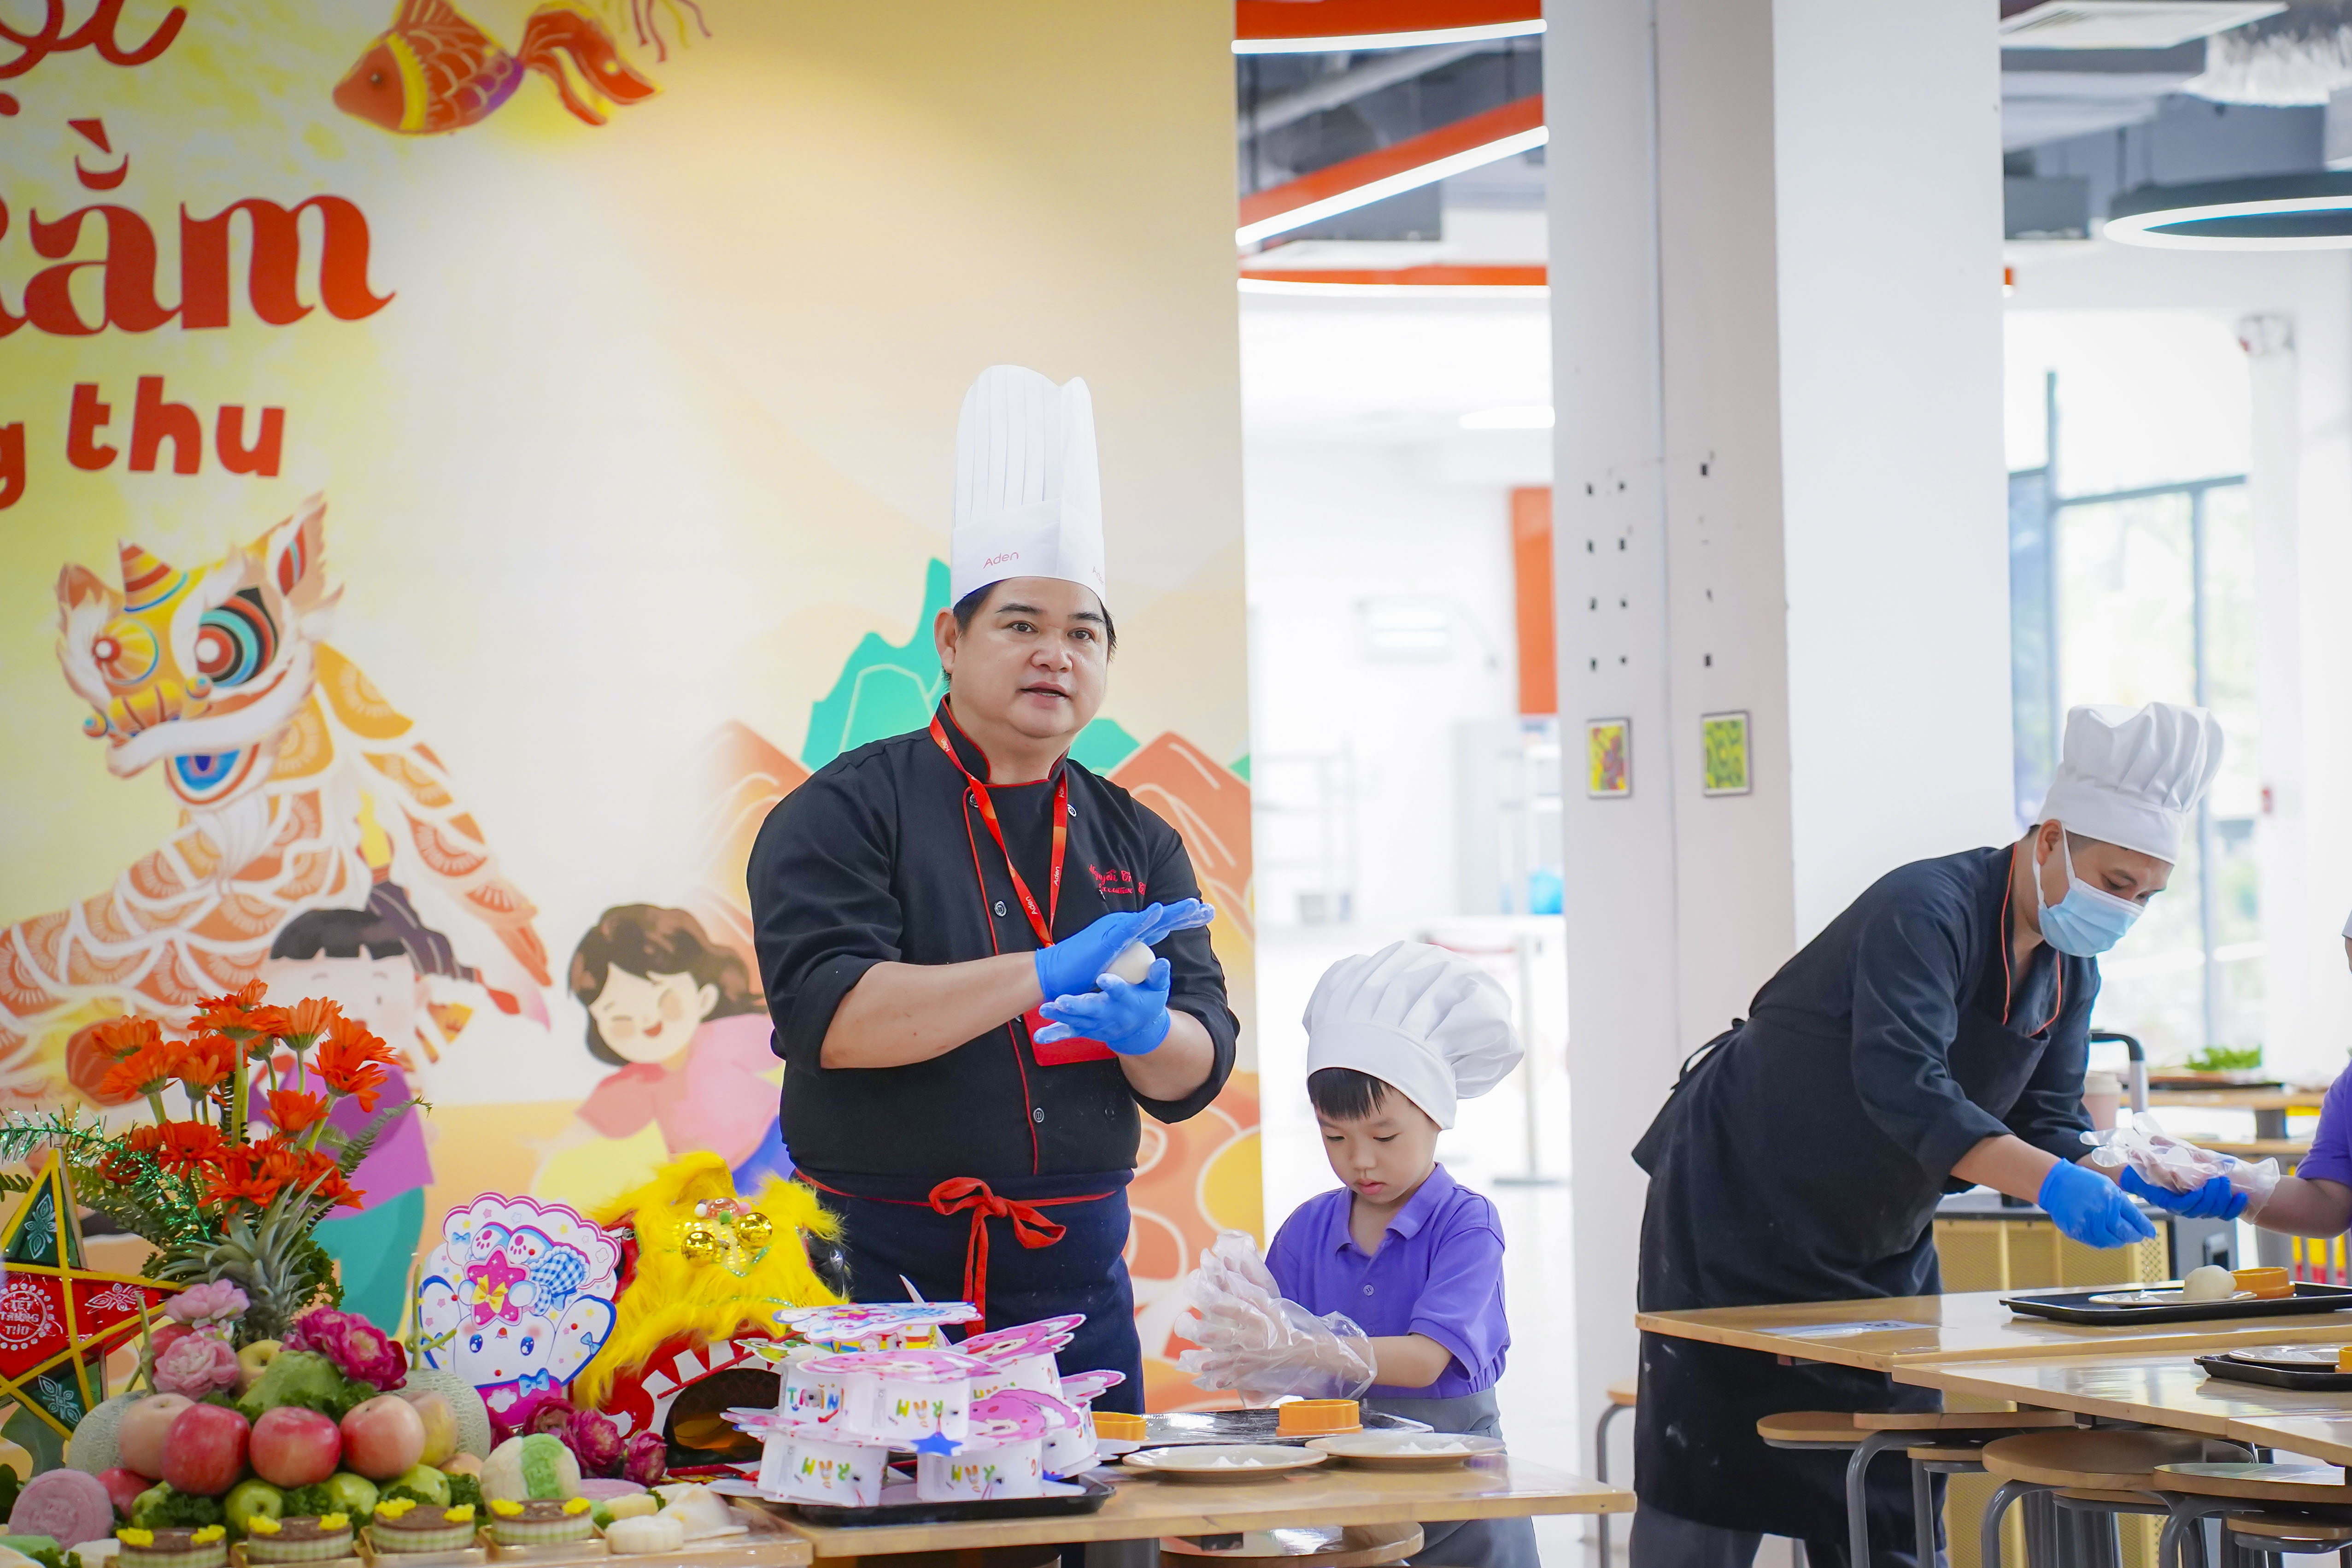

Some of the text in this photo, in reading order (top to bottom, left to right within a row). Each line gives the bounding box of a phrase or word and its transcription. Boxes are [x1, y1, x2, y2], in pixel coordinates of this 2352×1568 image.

[0, 118, 397, 339] ằm
[66, 375, 285, 477] thu
[983, 552, 1019, 569] Aden
[1025, 896, 1038, 915] Aden
